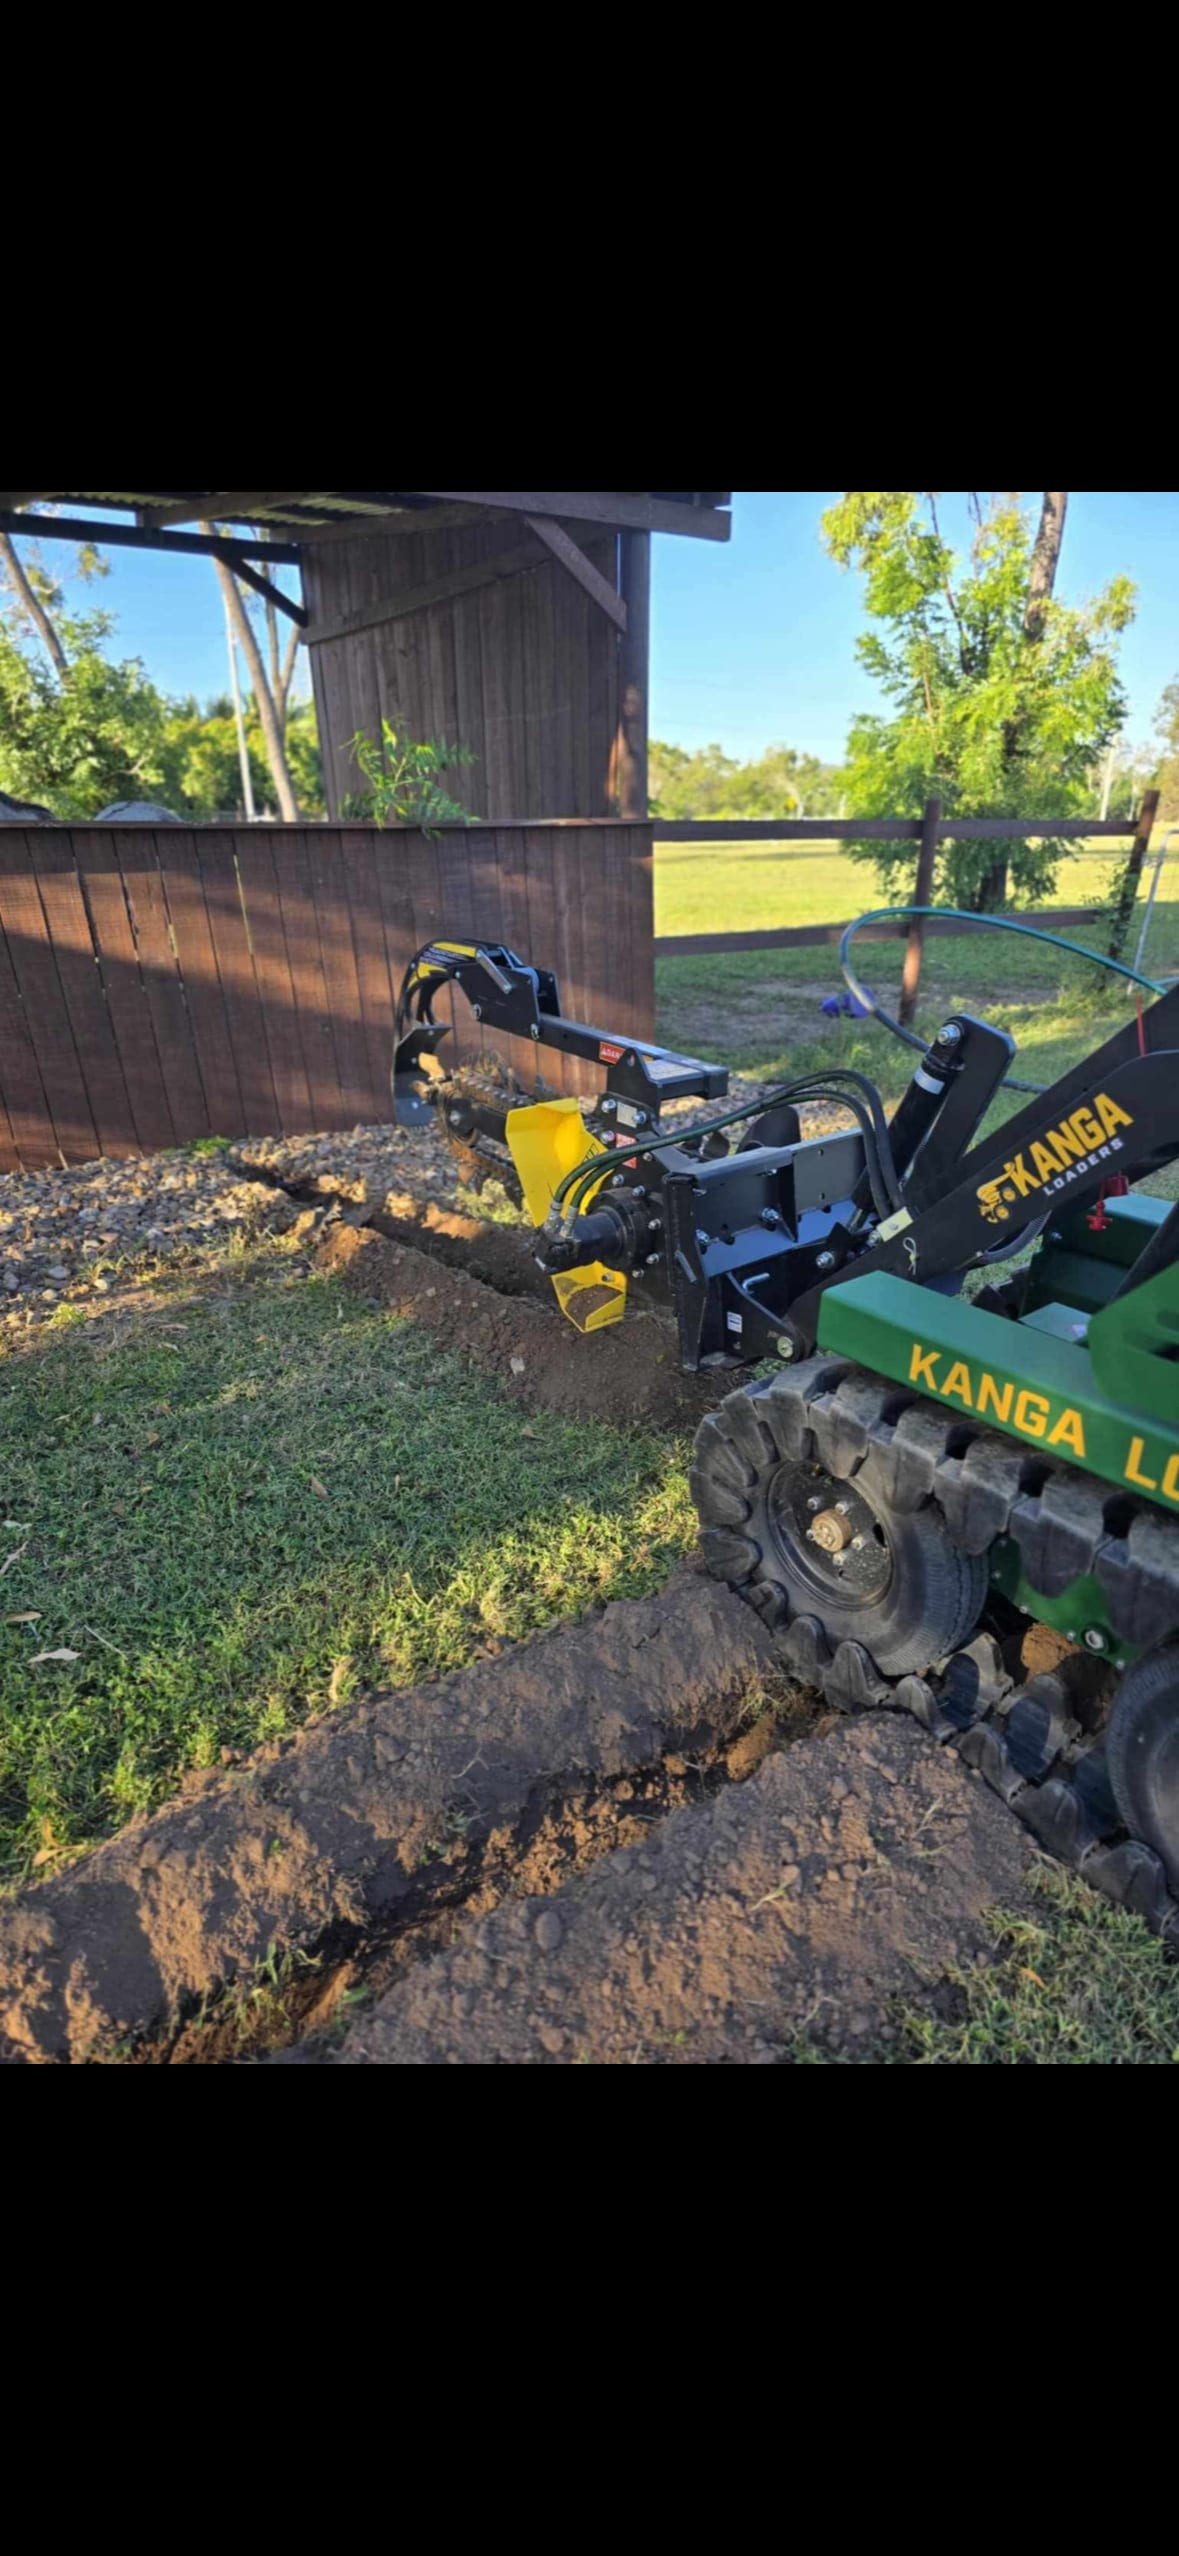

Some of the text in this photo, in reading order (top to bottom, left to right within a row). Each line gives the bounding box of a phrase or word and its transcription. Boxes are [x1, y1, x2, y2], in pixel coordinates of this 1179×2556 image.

[1004, 1093, 1134, 1197] KANGA
[1042, 1137, 1124, 1196] LOADERS
[909, 1343, 1086, 1458] KANGA
